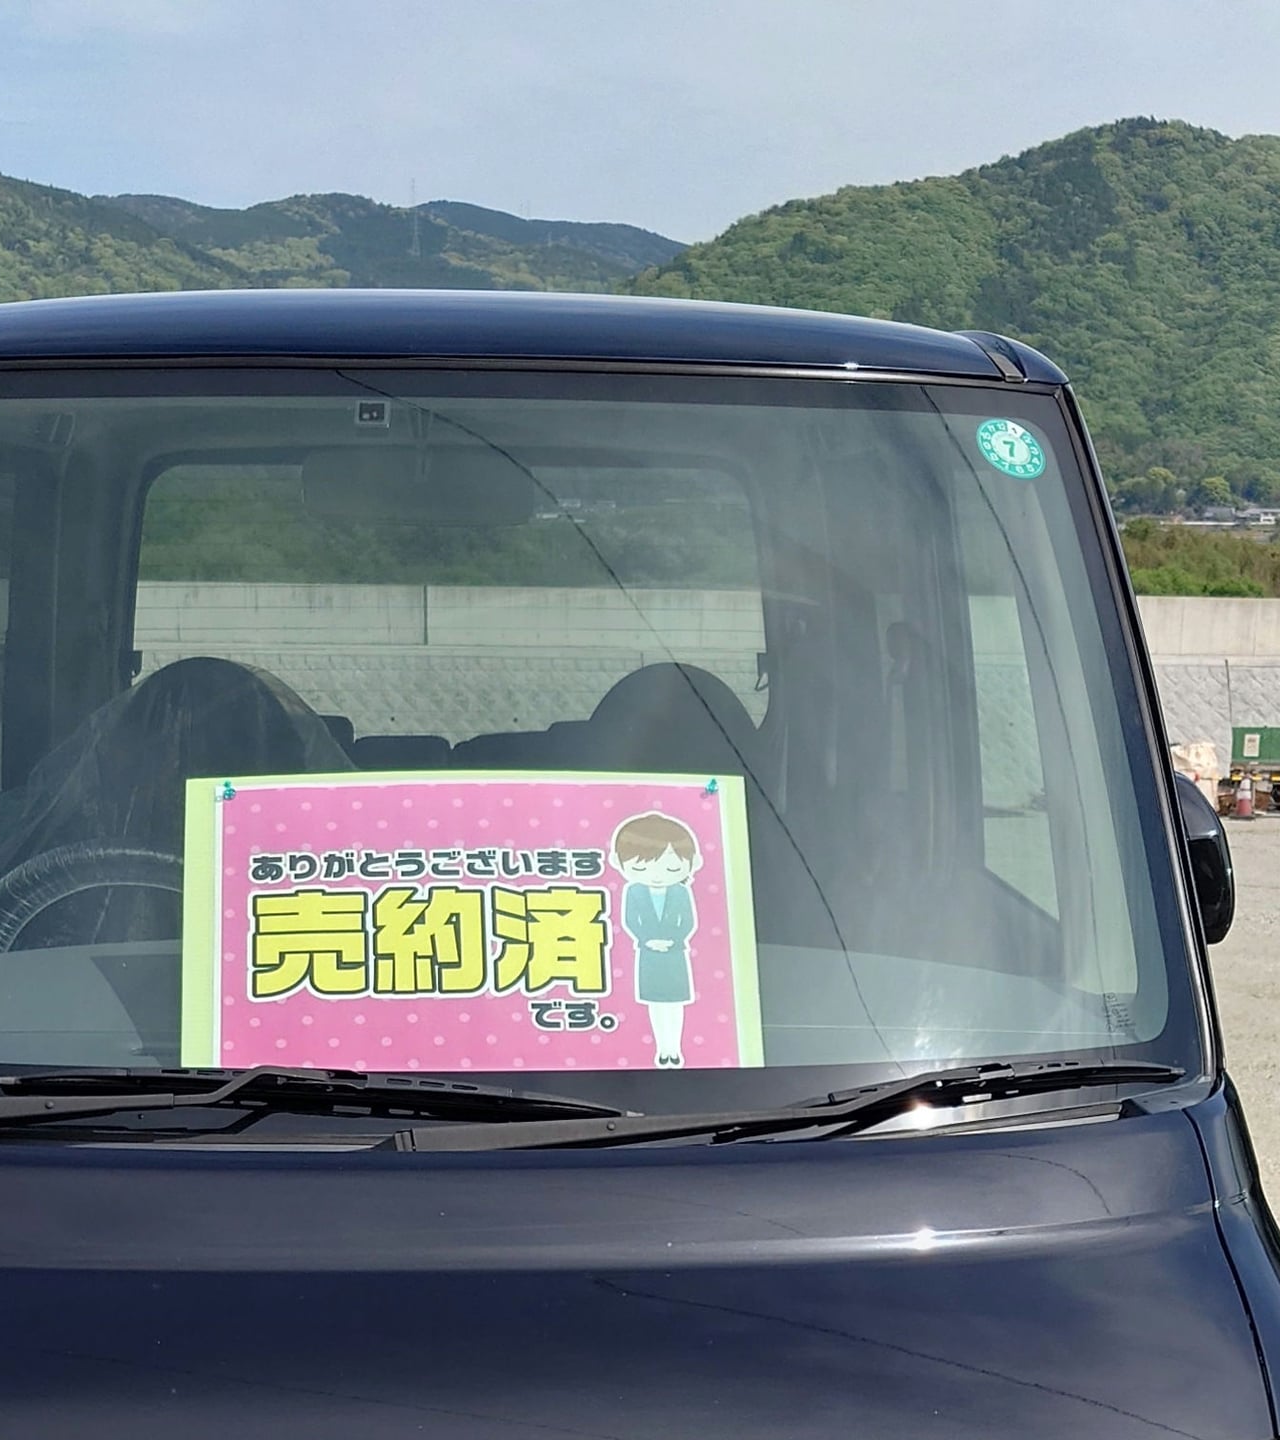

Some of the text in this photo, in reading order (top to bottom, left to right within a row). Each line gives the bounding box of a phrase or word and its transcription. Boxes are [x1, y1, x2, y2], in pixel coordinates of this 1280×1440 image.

[1002, 440, 1016, 458] 7
[251, 850, 602, 881] ありがとうございます
[251, 887, 607, 996] 売約済
[531, 1001, 617, 1030] です。
